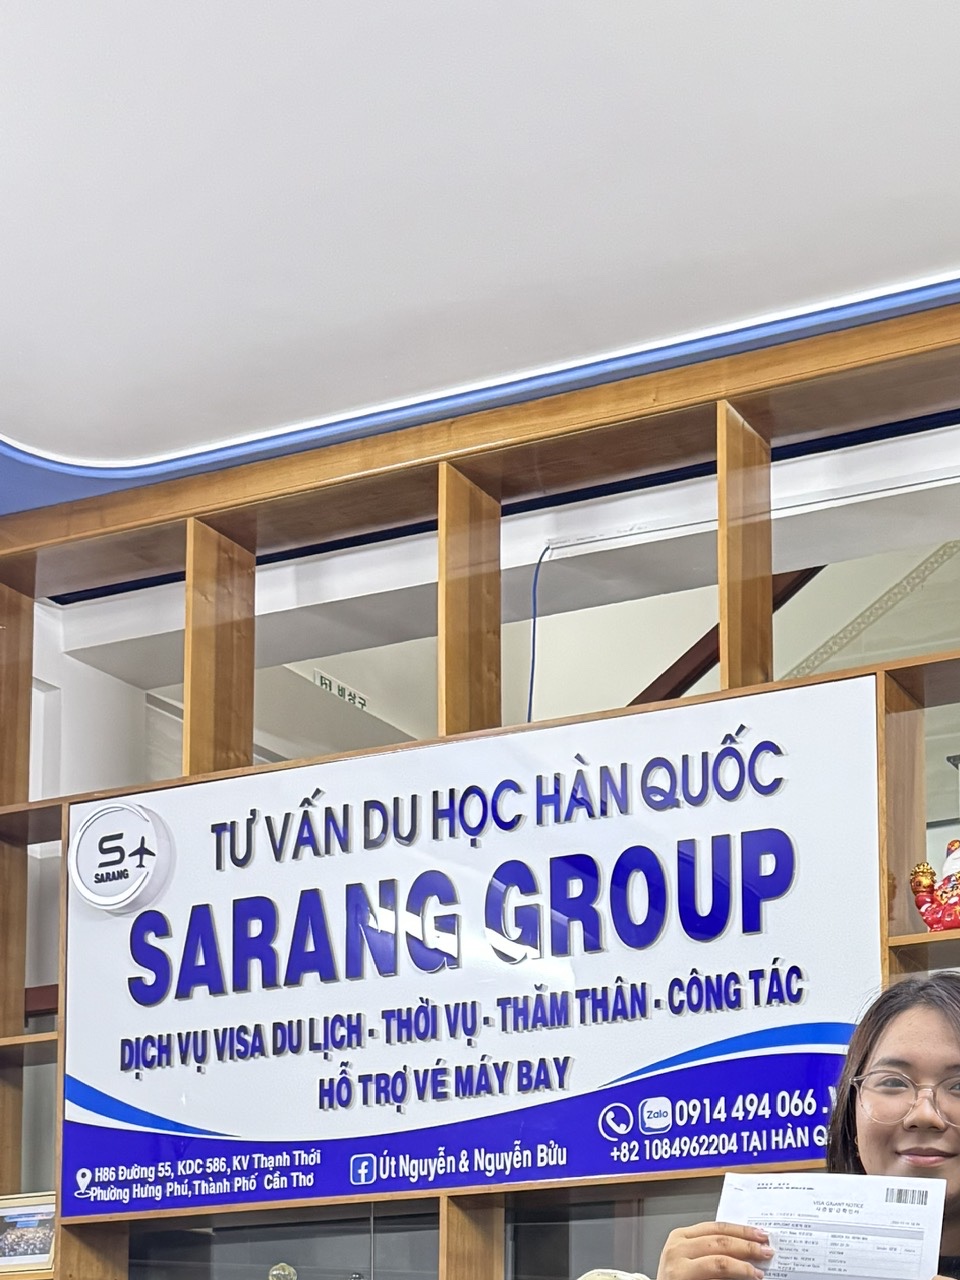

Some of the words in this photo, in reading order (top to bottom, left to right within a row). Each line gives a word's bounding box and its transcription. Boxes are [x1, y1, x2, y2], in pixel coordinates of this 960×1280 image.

[337, 684, 367, 709] 비상구
[211, 809, 257, 871] TƯ
[265, 788, 354, 862] VẤN
[364, 795, 418, 850] DU
[433, 779, 526, 848] HỌC
[536, 753, 630, 826] HÀN
[641, 724, 786, 811] QUỐC
[94, 869, 129, 884] SARANG
[128, 870, 463, 1007] SARANG
[485, 828, 797, 965] GROUP
[120, 1034, 174, 1080] DỊCH
[177, 1029, 209, 1074] VỤ
[213, 1023, 267, 1063] VISA
[272, 1018, 304, 1057] DU
[309, 1012, 364, 1061] LỊCH
[381, 996, 440, 1046] THỜI
[444, 1000, 481, 1048] VỤ
[497, 983, 573, 1033] THĂM
[575, 976, 650, 1026] THÂN
[668, 968, 743, 1016] CÔNG
[749, 957, 805, 1007] TÁC
[319, 1060, 354, 1111] HỖ
[358, 1064, 410, 1115] TRỢ
[413, 1058, 450, 1102] VÉ
[455, 1054, 513, 1100] MÁY
[517, 1055, 573, 1094] BAY
[646, 1109, 669, 1120] Zalo
[675, 1096, 727, 1127] 0914
[731, 1093, 771, 1121] 494
[776, 1088, 817, 1118] 066
[379, 1150, 396, 1180] Út
[399, 1146, 456, 1182] Nguyễn
[459, 1149, 470, 1173] &
[474, 1140, 532, 1177] Nguyễn
[537, 1140, 567, 1167] Bửu
[610, 1141, 640, 1162] +82
[643, 1133, 738, 1160] 1084962204
[741, 1129, 767, 1156] TẠI
[771, 1123, 810, 1150] HÀN
[94, 1165, 116, 1183] H86
[118, 1163, 155, 1183] Đường
[157, 1162, 175, 1179] 55,
[177, 1158, 203, 1176] KDC
[206, 1156, 231, 1176] 586,
[232, 1155, 249, 1171] KV
[252, 1152, 291, 1170] Thạnh
[293, 1148, 321, 1165] Thới
[90, 1184, 130, 1203] Phường
[132, 1182, 162, 1201] Hưng
[166, 1177, 192, 1198] Phú,
[193, 1177, 231, 1195] Thành
[234, 1172, 258, 1192] Phố
[264, 1173, 287, 1190] Cần
[290, 1172, 314, 1188] Thơ
